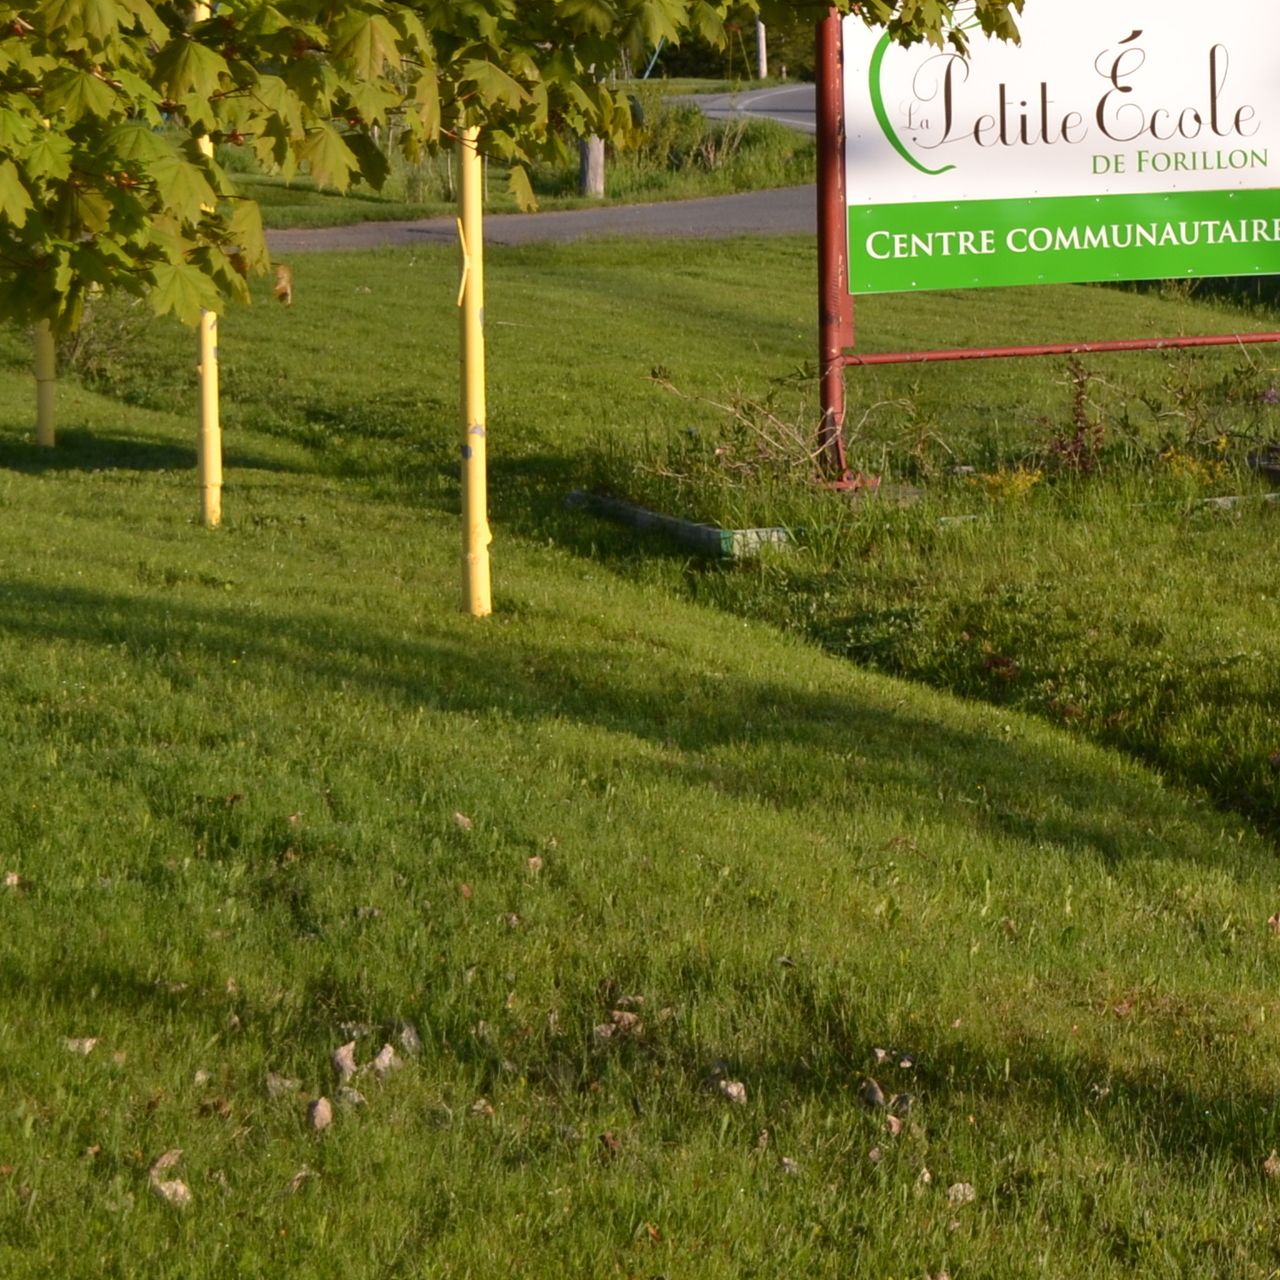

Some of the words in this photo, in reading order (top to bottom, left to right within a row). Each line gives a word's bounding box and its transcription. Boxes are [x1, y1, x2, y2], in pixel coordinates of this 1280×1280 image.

[912, 53, 1088, 149] Petite
[1094, 29, 1261, 144] École
[1092, 154, 1126, 174] DE
[1136, 149, 1269, 174] FORILLON
[866, 230, 996, 260] CENTRE
